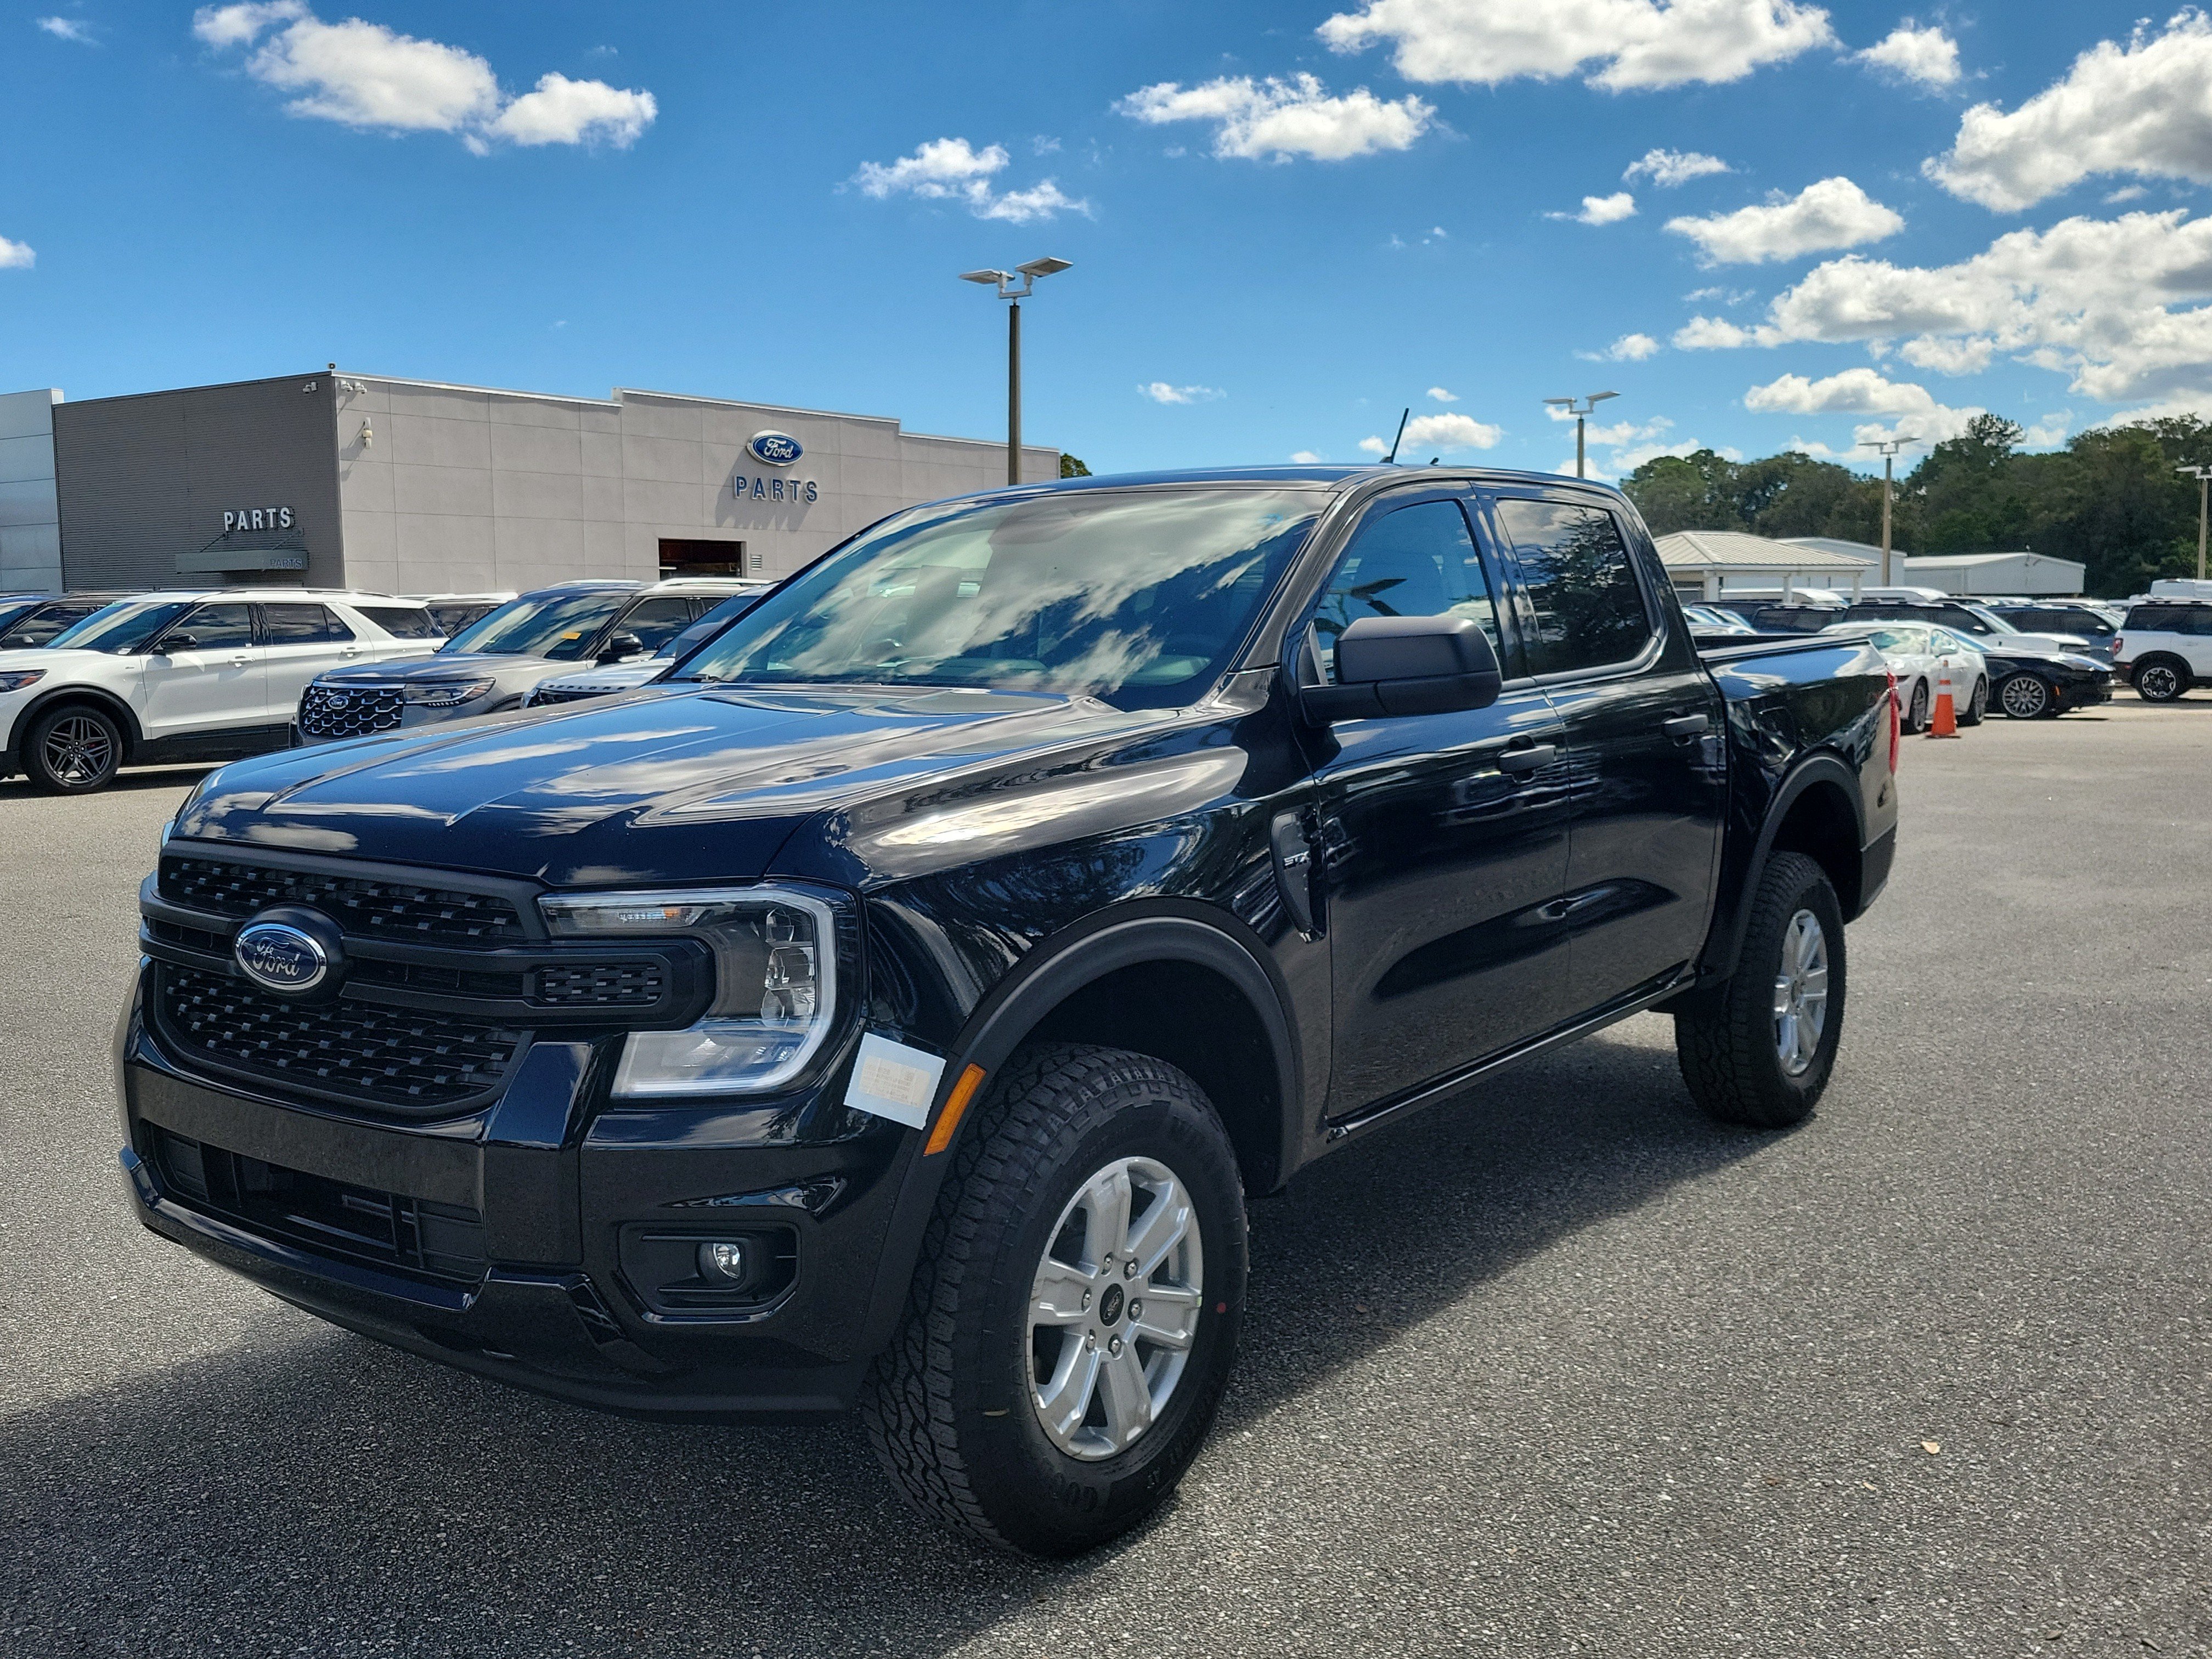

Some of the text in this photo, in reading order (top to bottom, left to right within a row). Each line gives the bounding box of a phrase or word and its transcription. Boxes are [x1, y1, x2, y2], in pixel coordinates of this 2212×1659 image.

[764, 438, 794, 459] Ford
[734, 475, 818, 504] PARTS
[224, 507, 292, 531] PARTS
[1284, 851, 1310, 866] STX
[252, 936, 301, 977] Ford
